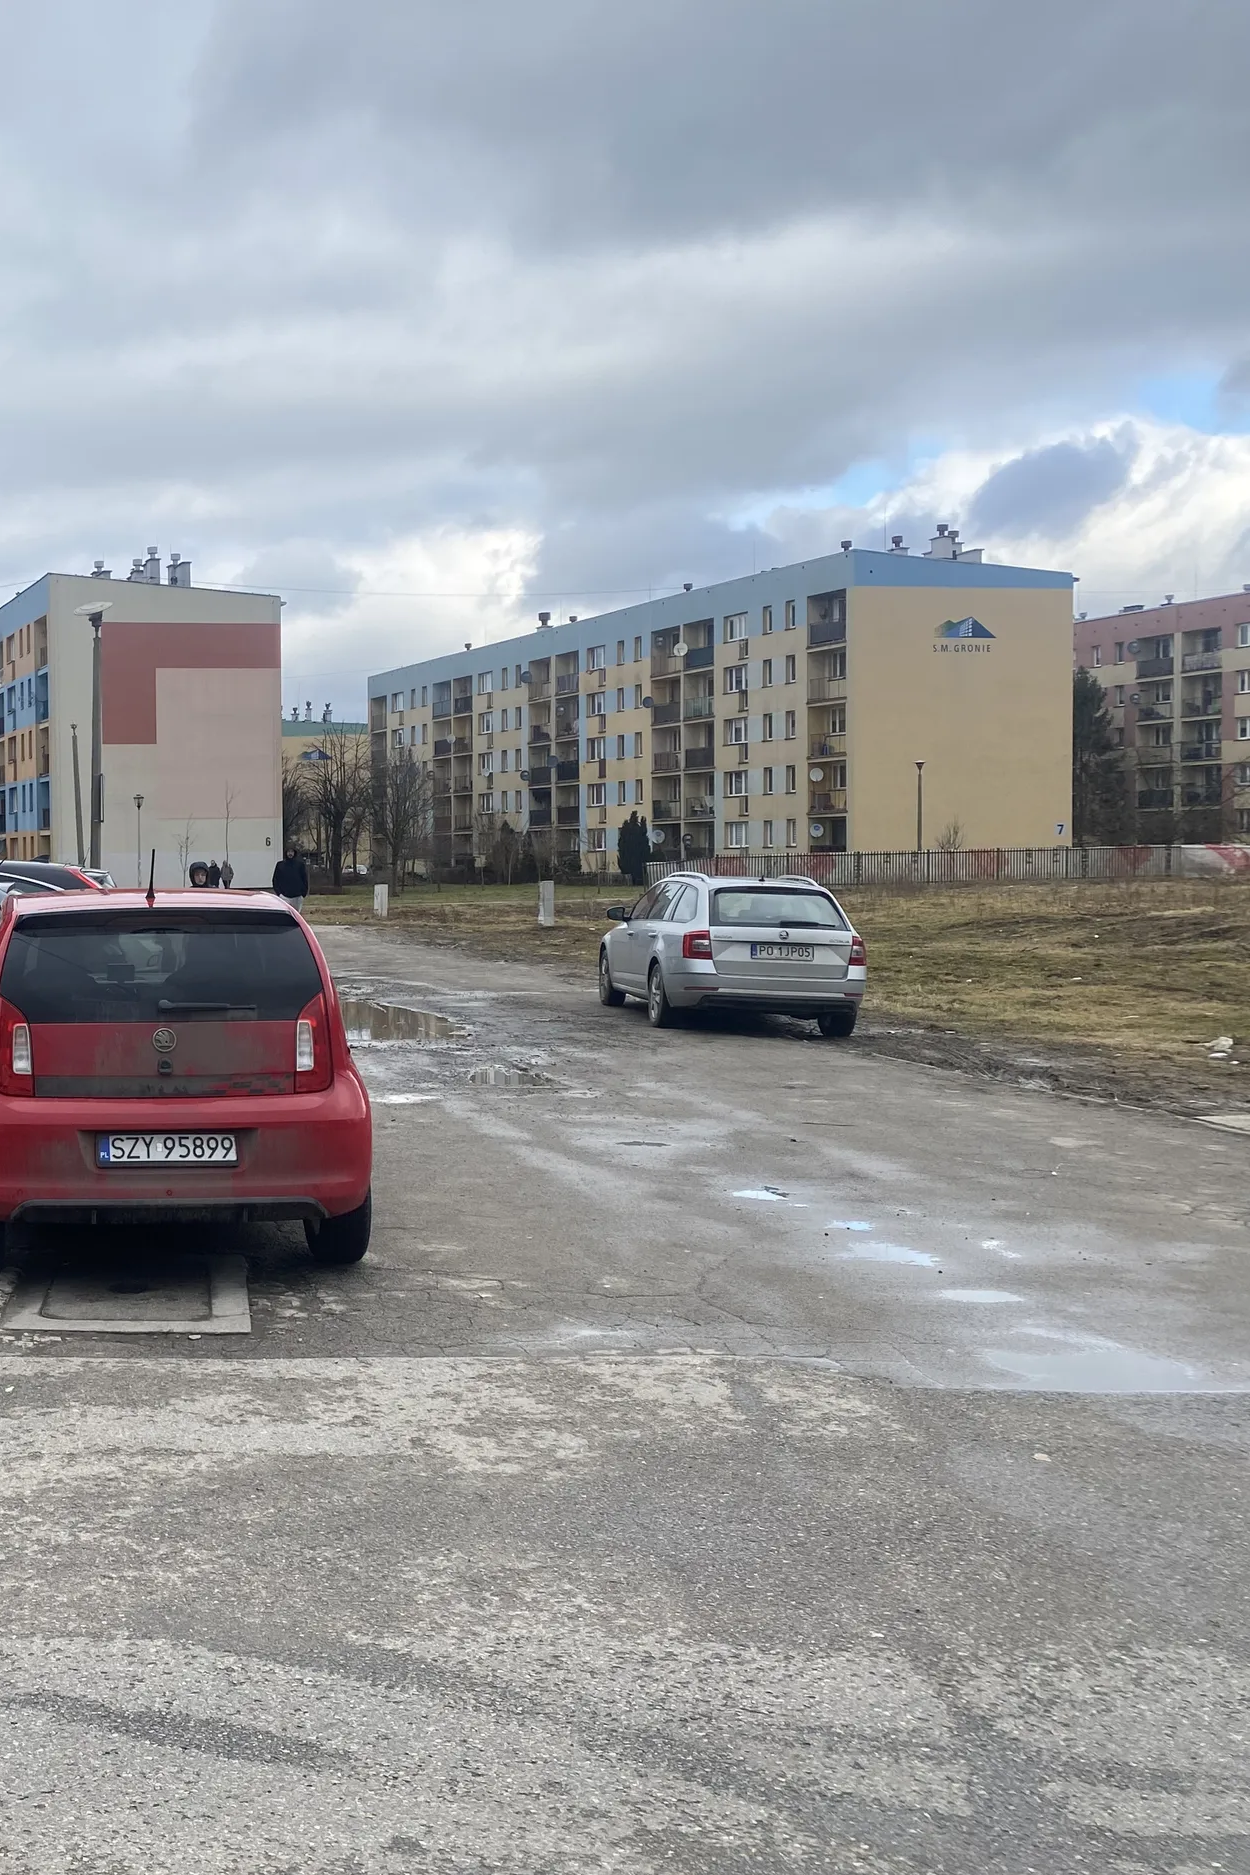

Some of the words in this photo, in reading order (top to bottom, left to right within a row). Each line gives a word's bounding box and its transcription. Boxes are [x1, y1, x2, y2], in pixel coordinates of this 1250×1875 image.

[932, 644, 952, 652] S.M.
[953, 644, 991, 653] GRONIE
[1056, 824, 1064, 835] 7
[265, 836, 271, 847] 6
[758, 945, 774, 956] PO
[778, 946, 811, 958] 1JP05
[111, 1136, 154, 1160] SZY
[163, 1136, 234, 1159] 95899
